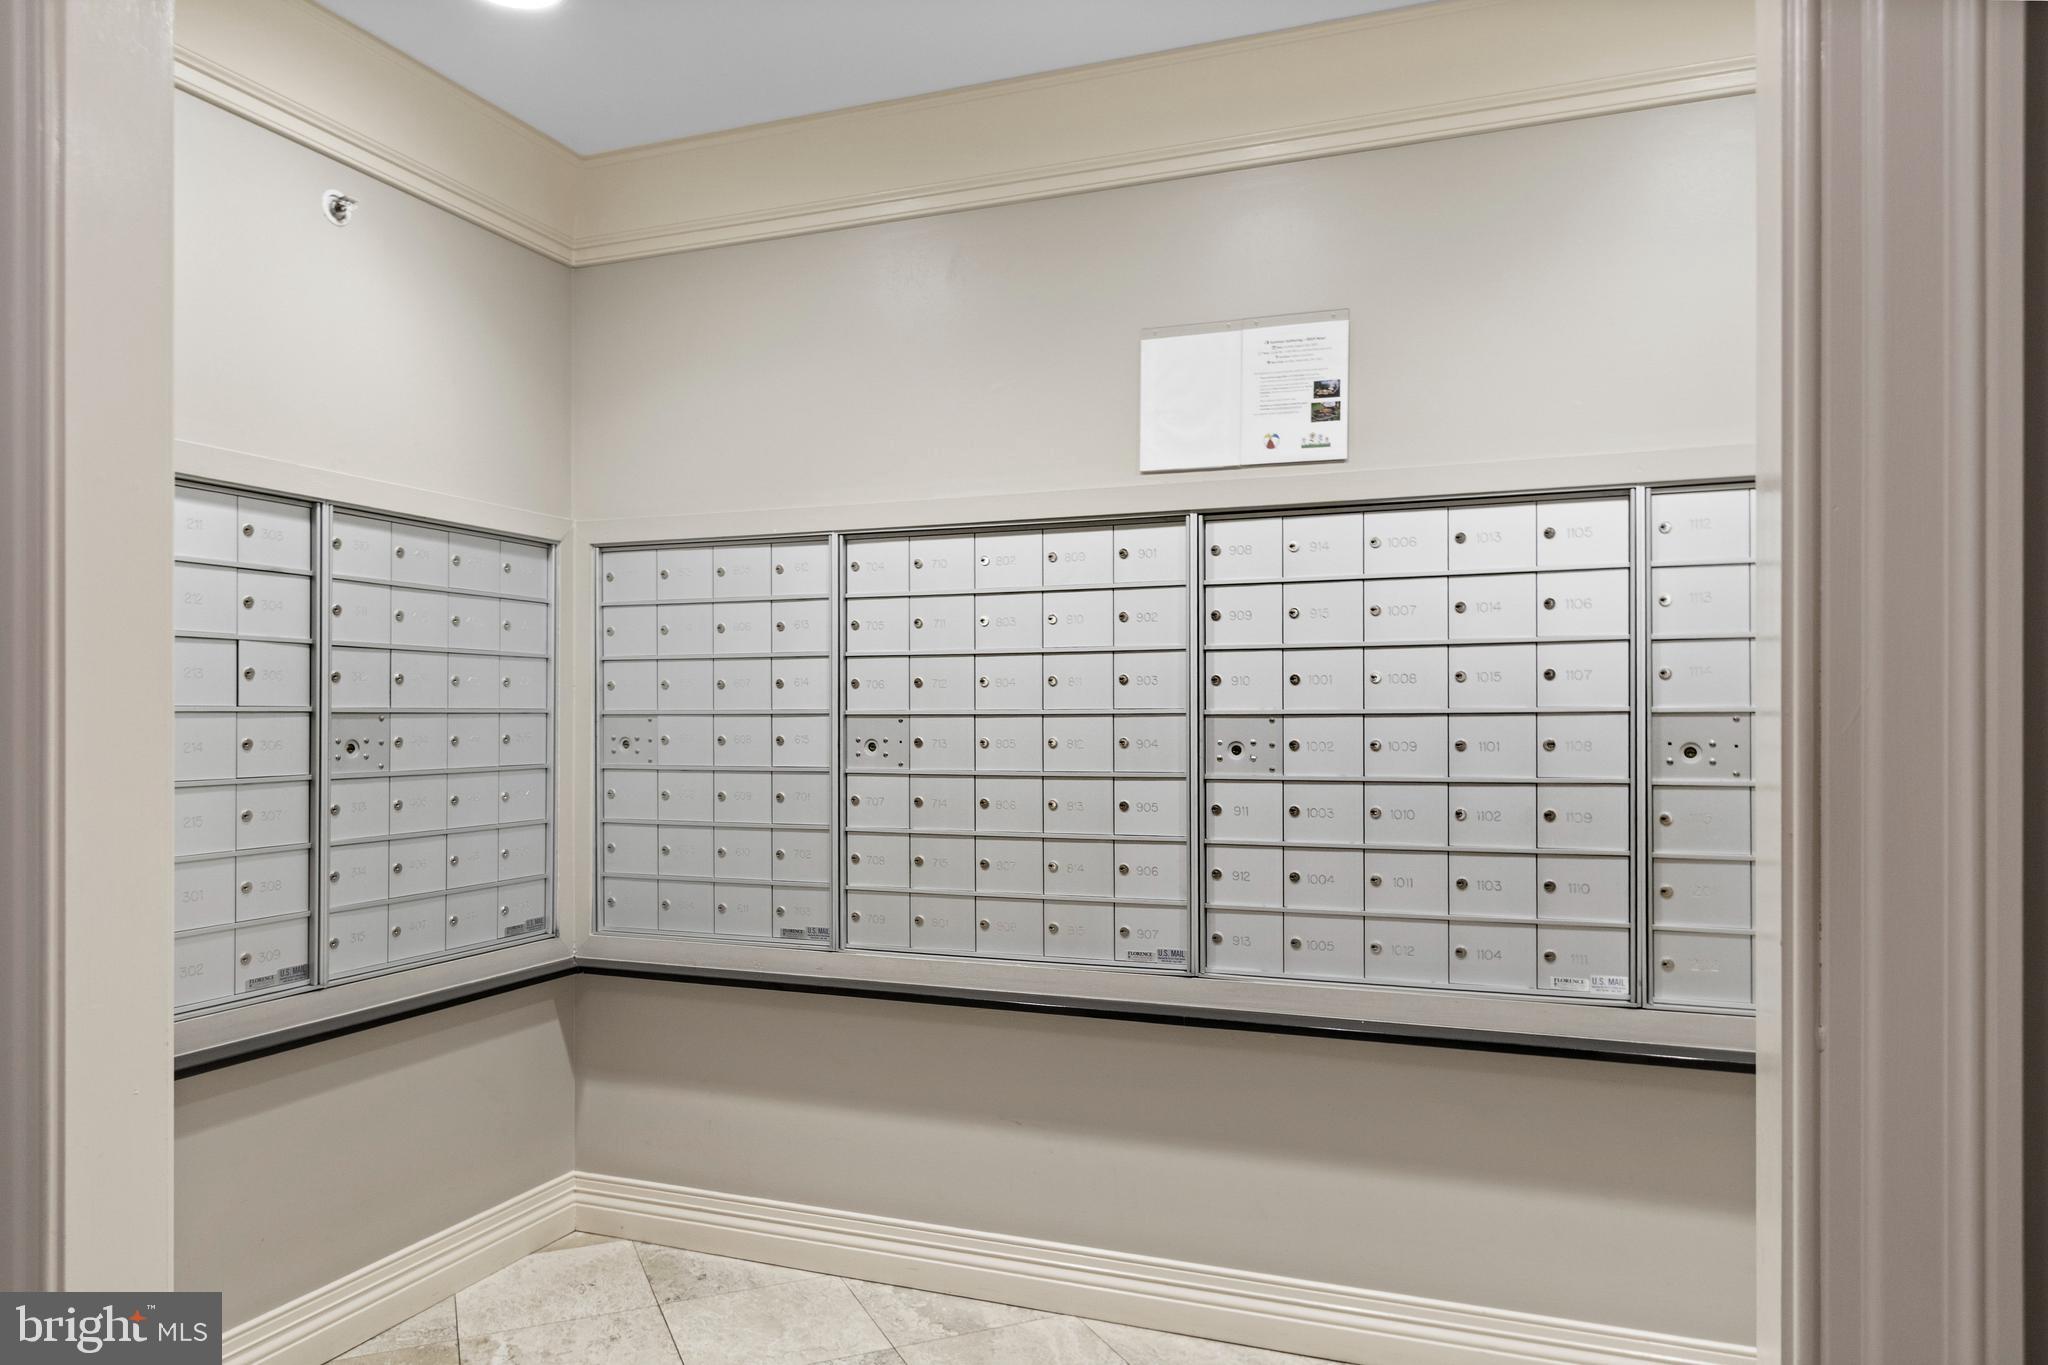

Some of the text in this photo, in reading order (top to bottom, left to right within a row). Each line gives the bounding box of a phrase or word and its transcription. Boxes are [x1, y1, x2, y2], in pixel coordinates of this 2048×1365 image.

[1690, 518, 1712, 530] 1112
[1476, 532, 1502, 543] 1013
[1566, 527, 1593, 538] 1105
[1309, 541, 1330, 552] 914
[1387, 537, 1417, 547] 1006
[1138, 548, 1157, 559] 901
[1228, 544, 1252, 555] 908
[931, 558, 948, 569] 710
[1476, 602, 1501, 613] 1014
[1566, 598, 1593, 610] 1106
[1229, 610, 1253, 621] 909
[1309, 608, 1330, 619] 915
[1387, 605, 1417, 616] 1007
[1136, 612, 1159, 623] 902
[1136, 675, 1159, 686] 903
[1308, 674, 1333, 685] 1001
[1387, 673, 1417, 684] 1008
[1476, 671, 1502, 683] 1015
[1566, 669, 1593, 681] 1107
[866, 679, 885, 689] 706
[1231, 676, 1251, 687] 910
[1136, 738, 1159, 749] 904
[1307, 741, 1336, 752] 1002
[1388, 741, 1418, 752] 1009
[1479, 741, 1500, 752] 1101
[1565, 740, 1593, 752] 1108
[1136, 802, 1159, 813] 905
[1233, 806, 1249, 817] 911
[1307, 808, 1336, 819] 1003
[1391, 809, 1416, 820] 1010
[1477, 810, 1502, 822] 1102
[1566, 812, 1593, 824] 1109
[183, 816, 204, 829] 215
[1136, 866, 1159, 877] 906
[1232, 871, 1251, 882] 912
[1307, 875, 1336, 886] 1004
[1393, 877, 1414, 888] 1011
[1477, 880, 1503, 892] 1103
[1568, 883, 1591, 894] 1110
[181, 890, 204, 903] 301
[1137, 928, 1160, 940] 907
[1232, 936, 1252, 947] 913
[1307, 940, 1336, 951] 1005
[257, 949, 282, 963] 309
[1170, 949, 1185, 958] MAIL
[1477, 948, 1503, 960] 1104
[1571, 954, 1589, 965] 1111
[179, 963, 205, 979] 302
[1591, 976, 1625, 987] U.S. MAIL
